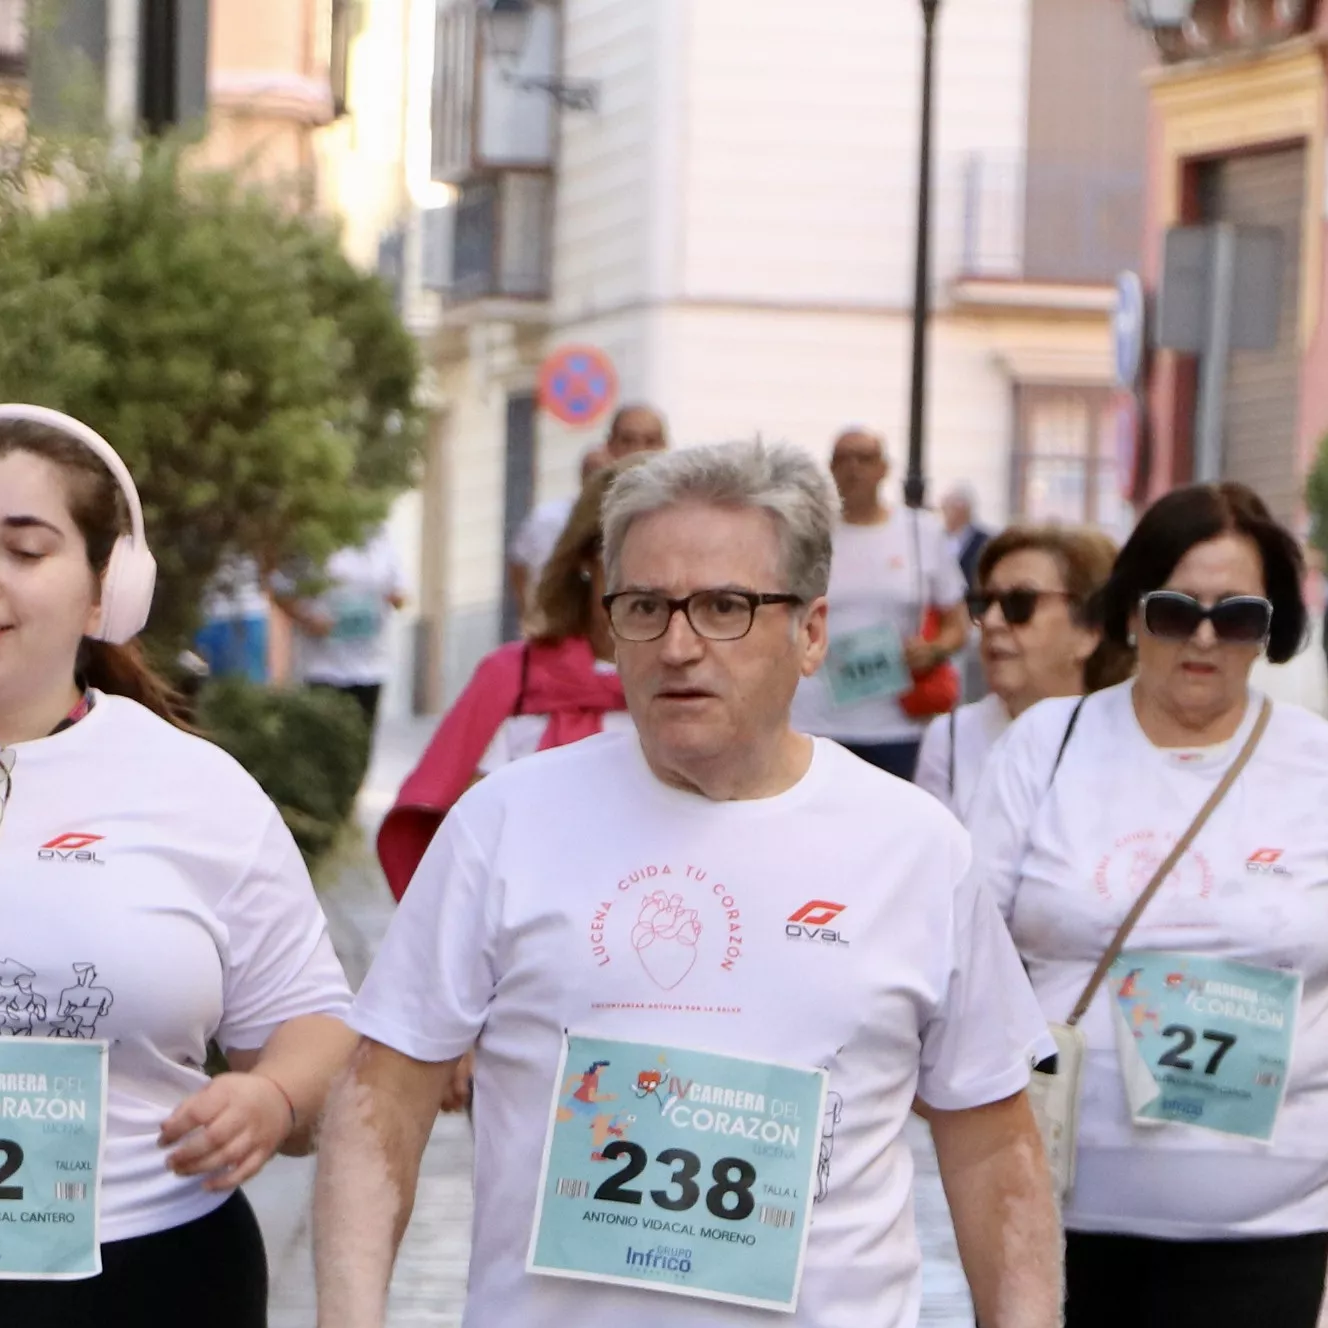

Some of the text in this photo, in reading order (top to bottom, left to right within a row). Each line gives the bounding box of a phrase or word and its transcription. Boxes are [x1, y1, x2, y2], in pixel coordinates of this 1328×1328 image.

[590, 864, 744, 973] LUCENA CUIDA TU CORAZÓN
[1157, 1022, 1238, 1076] 27
[53, 1076, 84, 1093] DEL
[668, 1076, 801, 1120] IV CARRERA DEL
[593, 1139, 757, 1221] 238
[762, 1184, 790, 1195] TALLA
[20, 1211, 75, 1224] CANTERO
[582, 1210, 756, 1246] ANTONIO VIDACAL MORENO
[625, 1246, 692, 1273] Infrico
[656, 1244, 692, 1258] GRUPO
